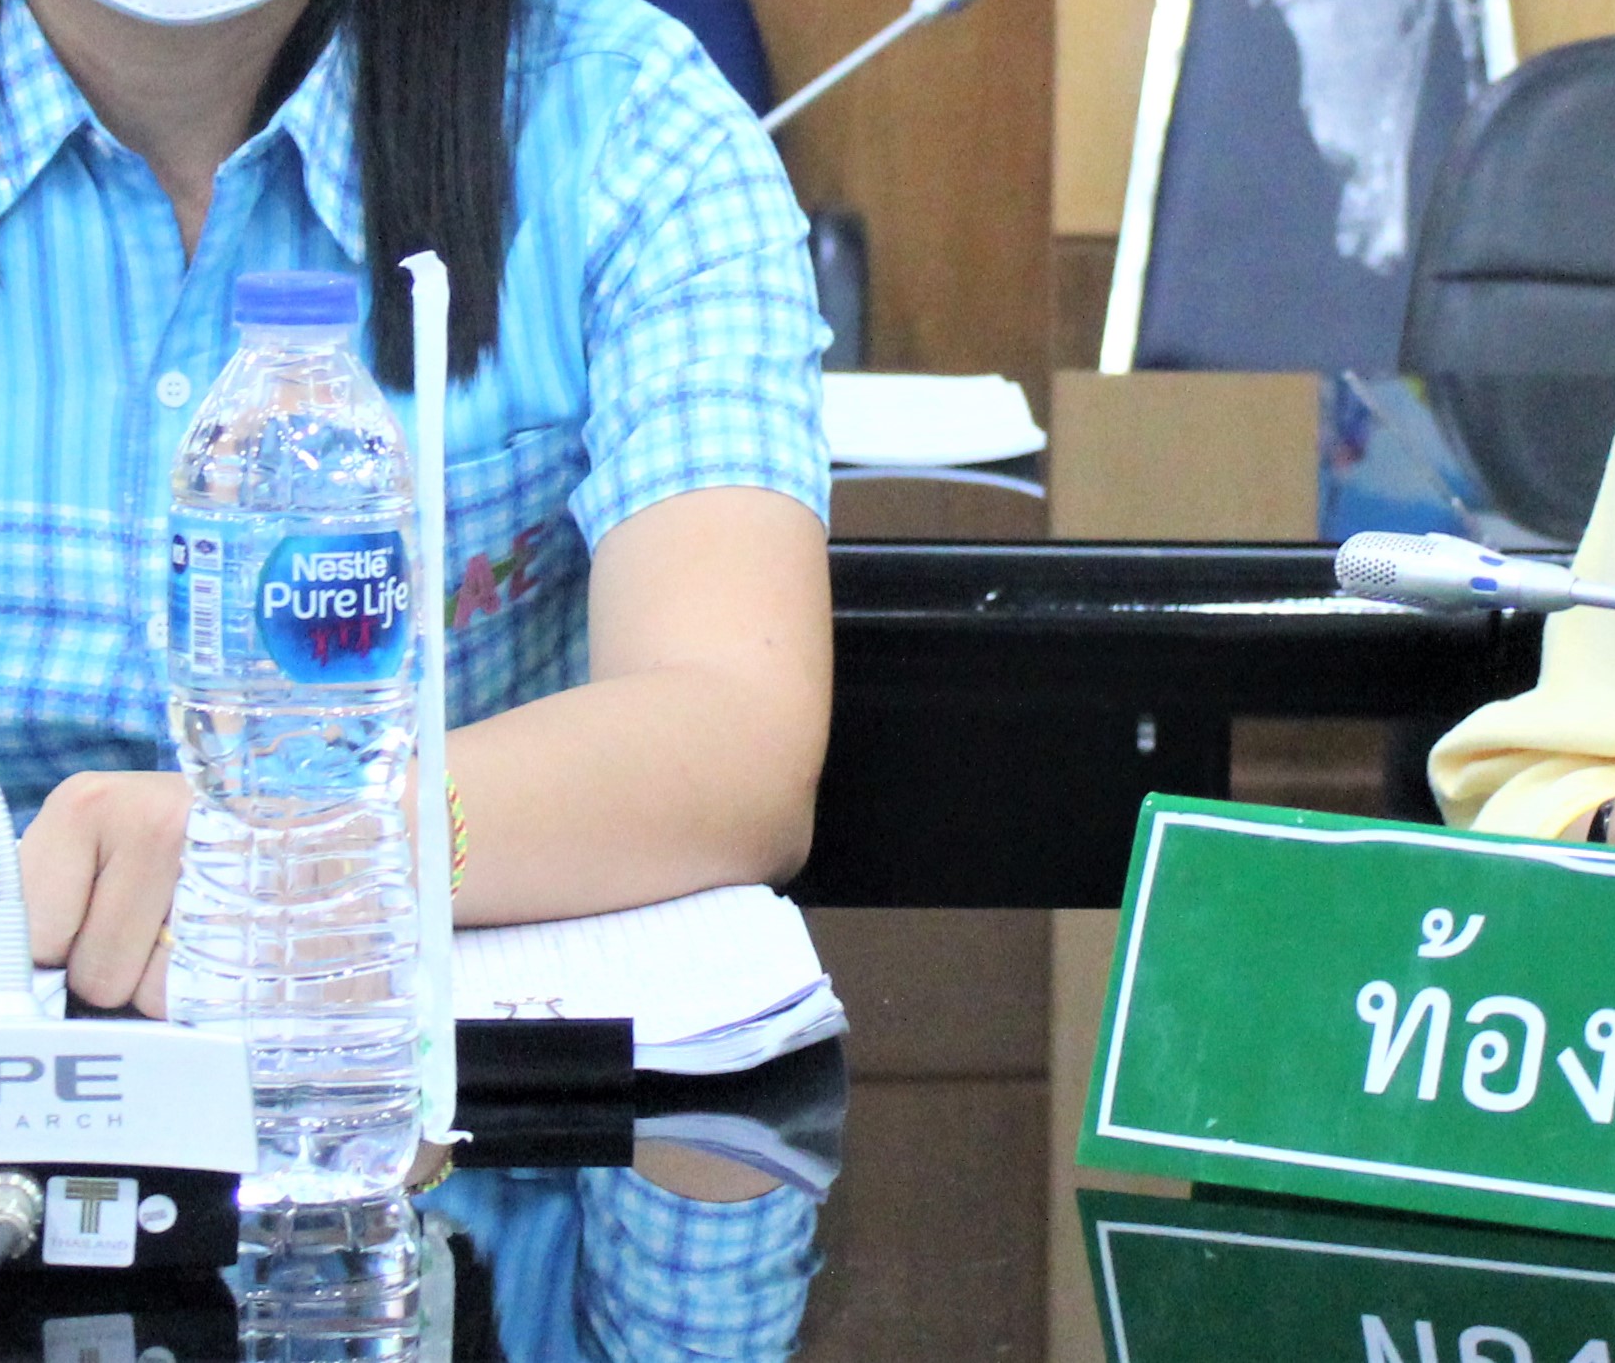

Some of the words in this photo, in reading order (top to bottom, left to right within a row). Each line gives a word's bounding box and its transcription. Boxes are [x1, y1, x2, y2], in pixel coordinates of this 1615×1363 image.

[291, 548, 389, 583] Nestlé
[263, 582, 358, 620] Pure
[364, 576, 410, 630] Life
